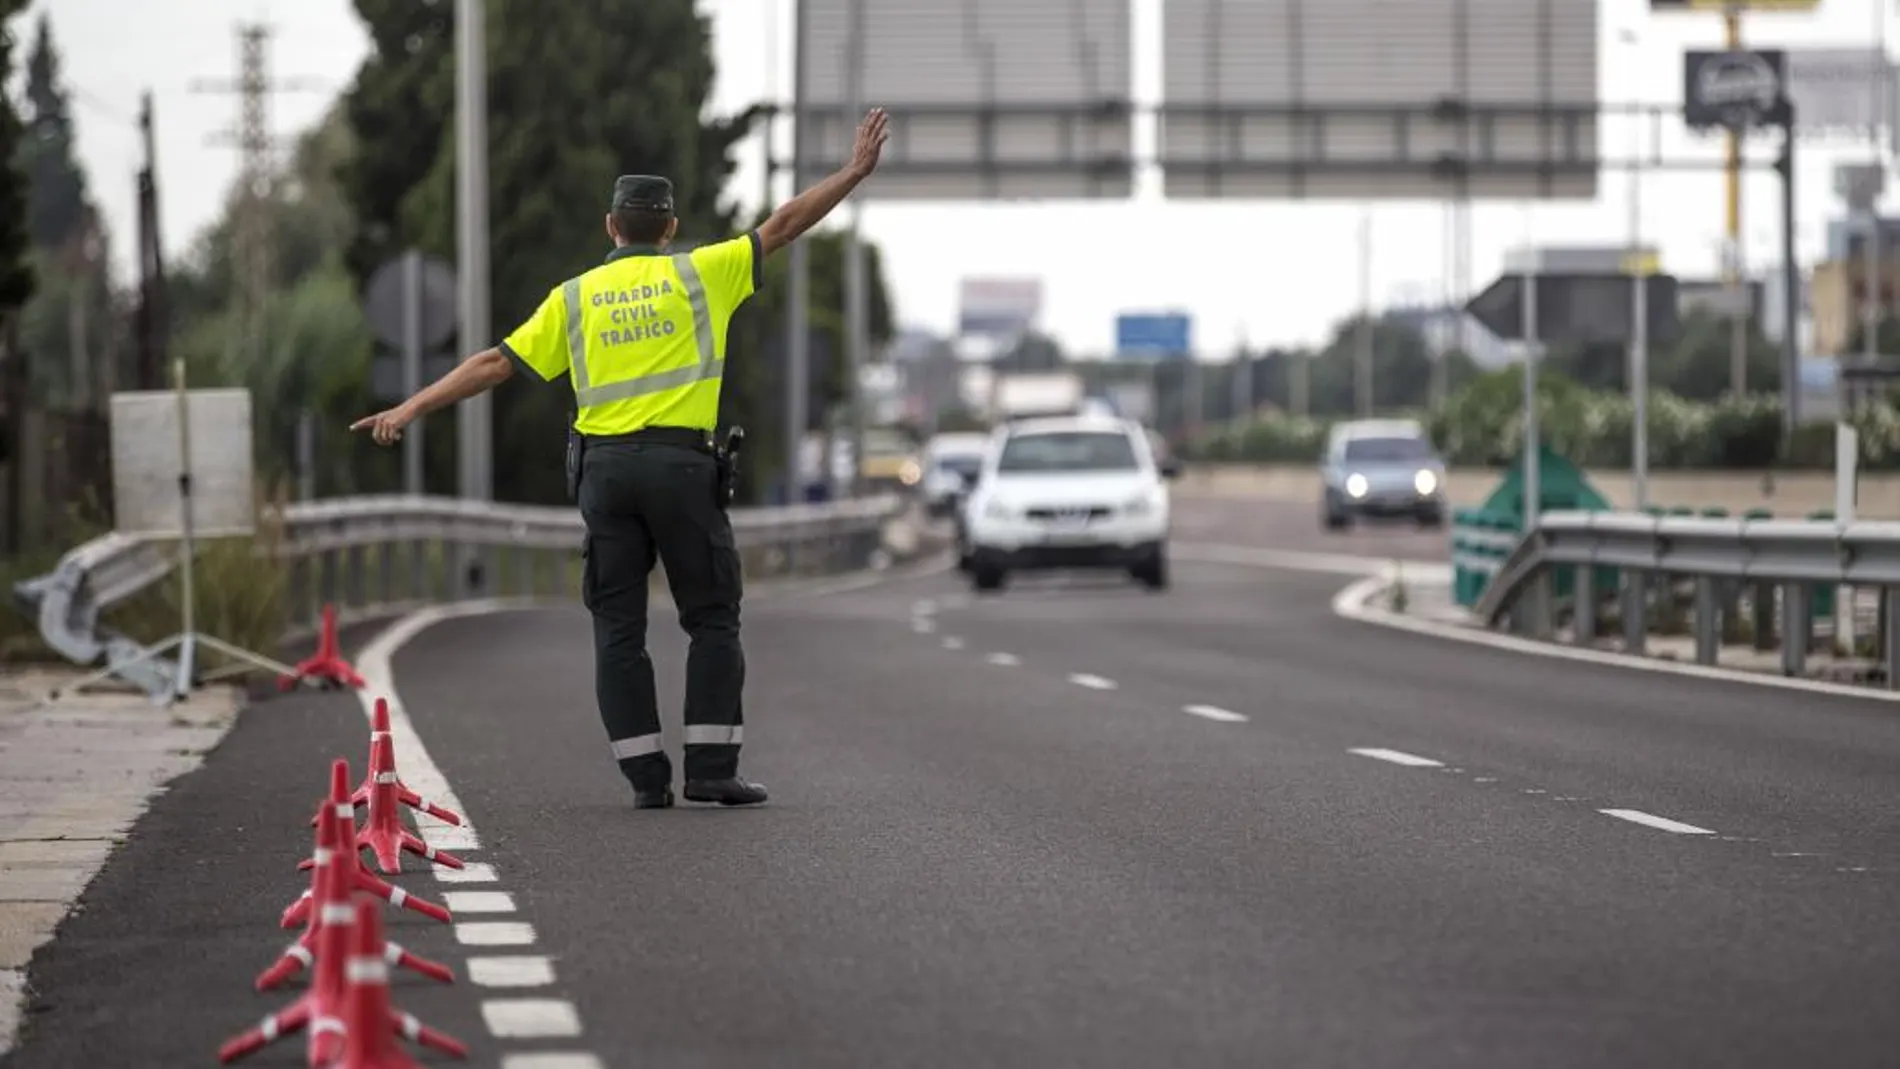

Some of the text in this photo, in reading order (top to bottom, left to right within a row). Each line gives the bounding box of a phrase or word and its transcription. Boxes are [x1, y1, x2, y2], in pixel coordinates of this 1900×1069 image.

[592, 280, 672, 306] GUARDIA
[611, 304, 657, 324] CIVIL
[601, 320, 675, 347] TRAFICO
